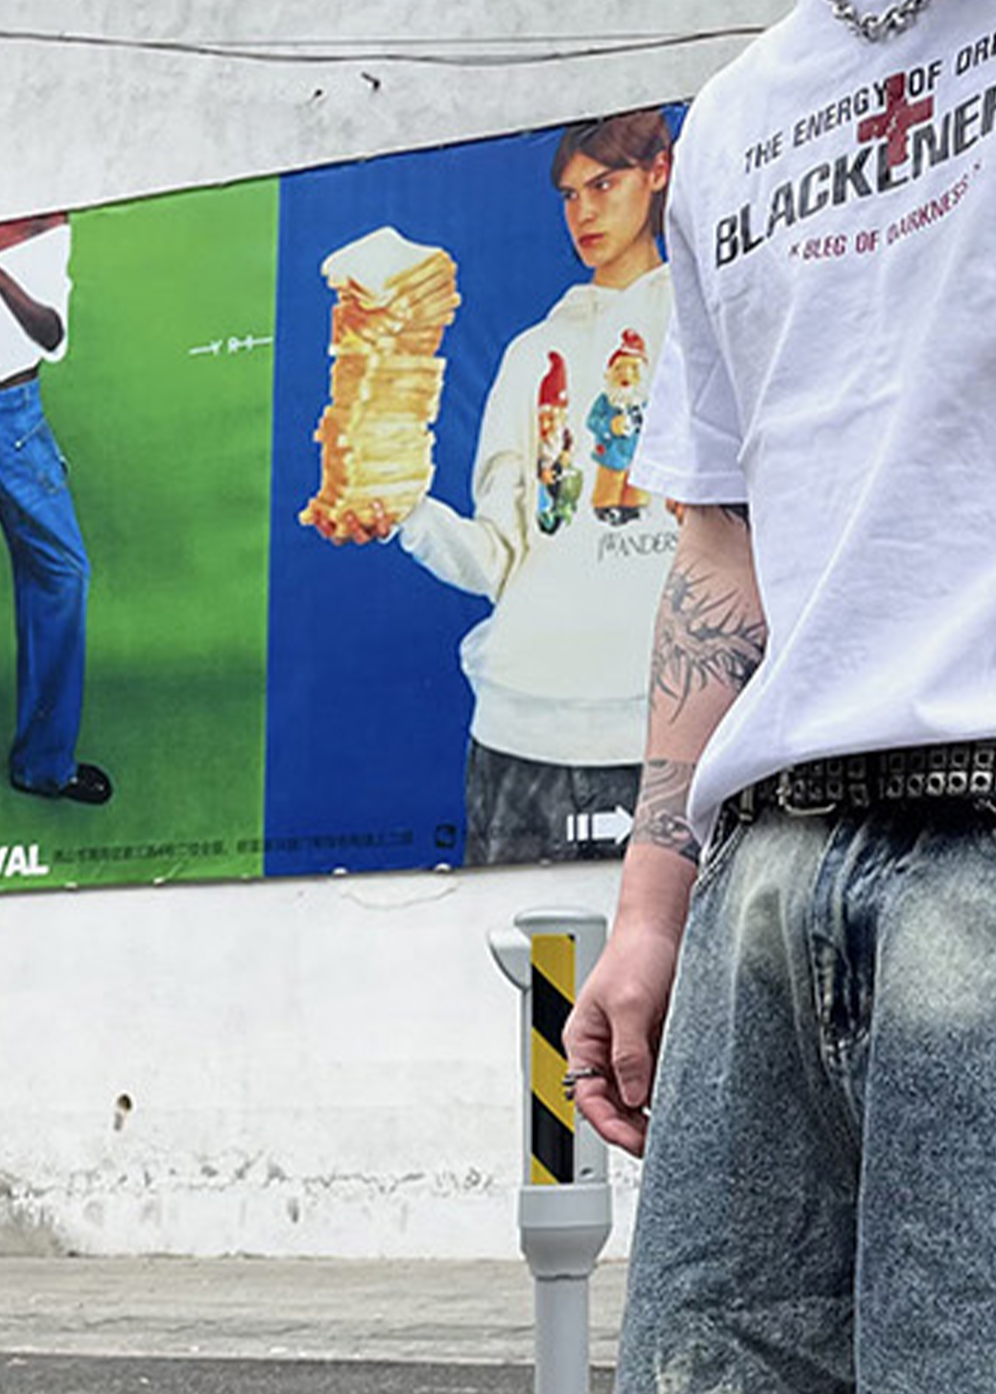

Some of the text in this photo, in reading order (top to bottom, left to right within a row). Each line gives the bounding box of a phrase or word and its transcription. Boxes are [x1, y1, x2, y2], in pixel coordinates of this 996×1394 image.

[744, 131, 783, 173] THE
[793, 77, 890, 147] ENERGY
[908, 60, 942, 97] OF
[856, 229, 880, 254] OF
